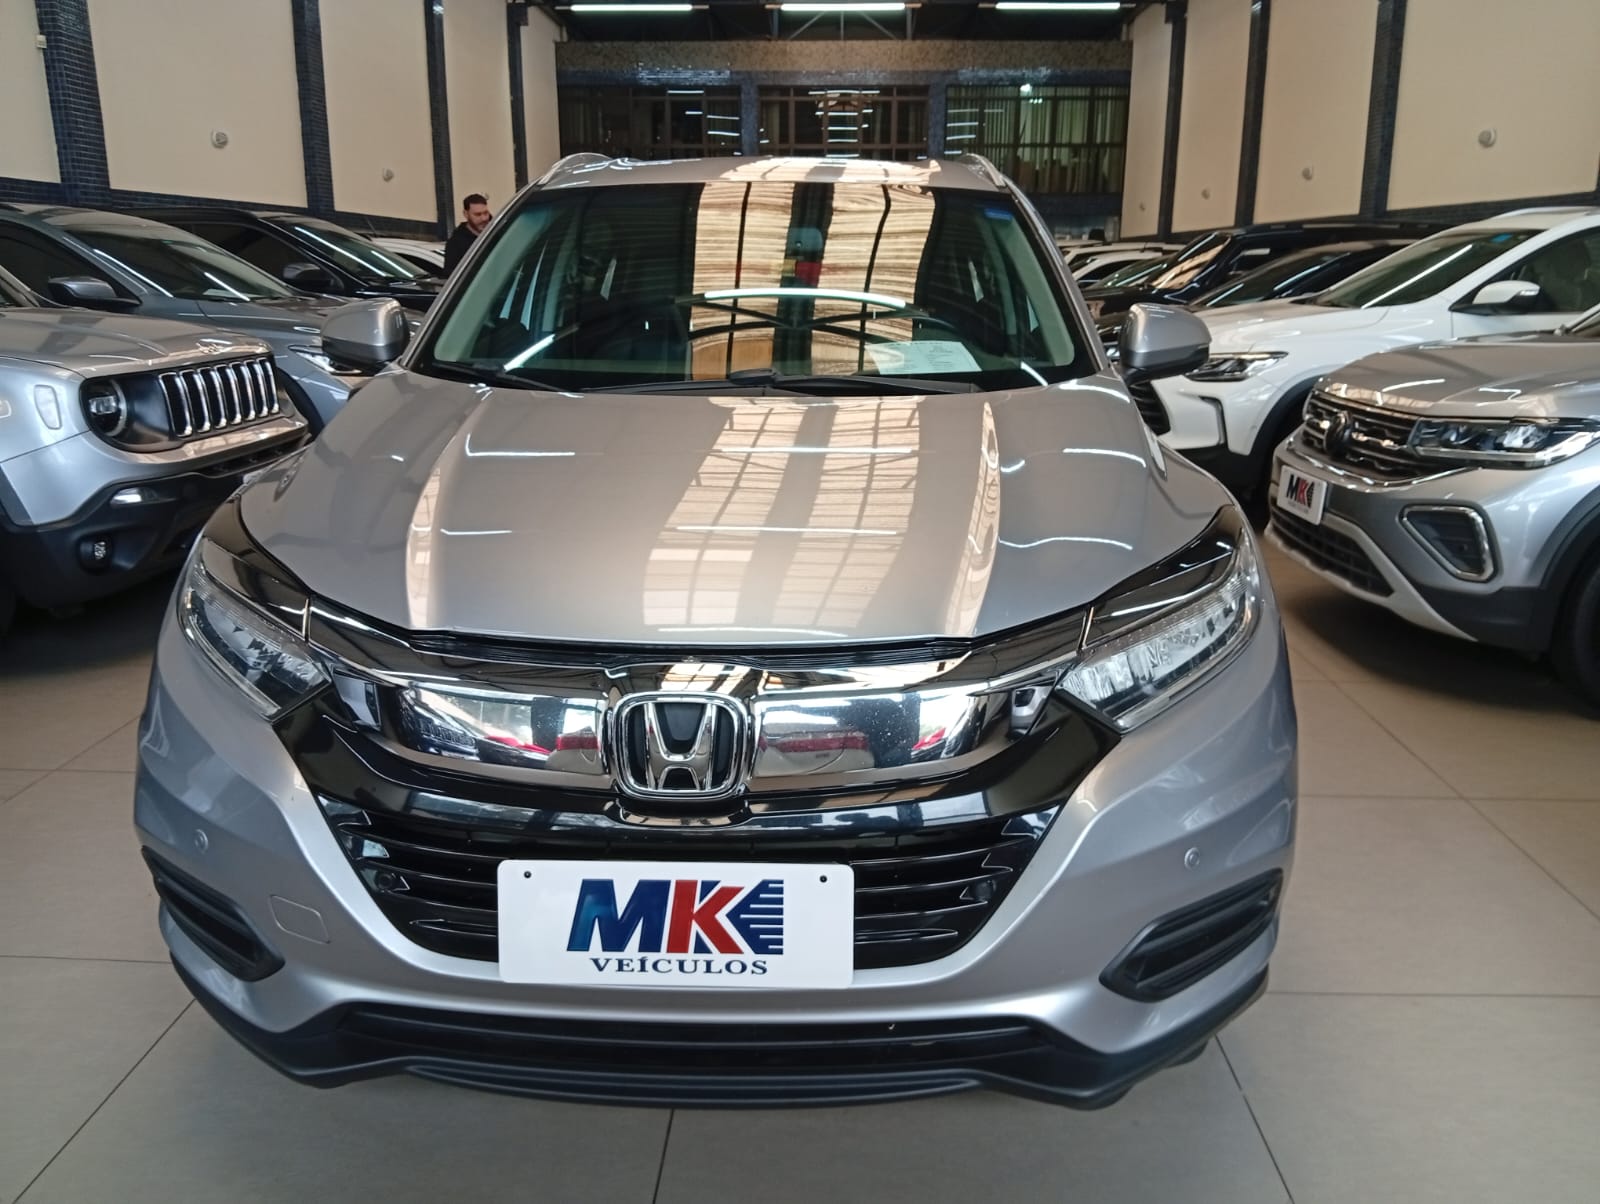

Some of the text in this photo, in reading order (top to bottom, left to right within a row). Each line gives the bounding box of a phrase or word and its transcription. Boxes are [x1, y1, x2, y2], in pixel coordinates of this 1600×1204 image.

[1286, 474, 1310, 506] MK
[566, 878, 745, 955] MK
[589, 956, 768, 976] VEÍCULOS
